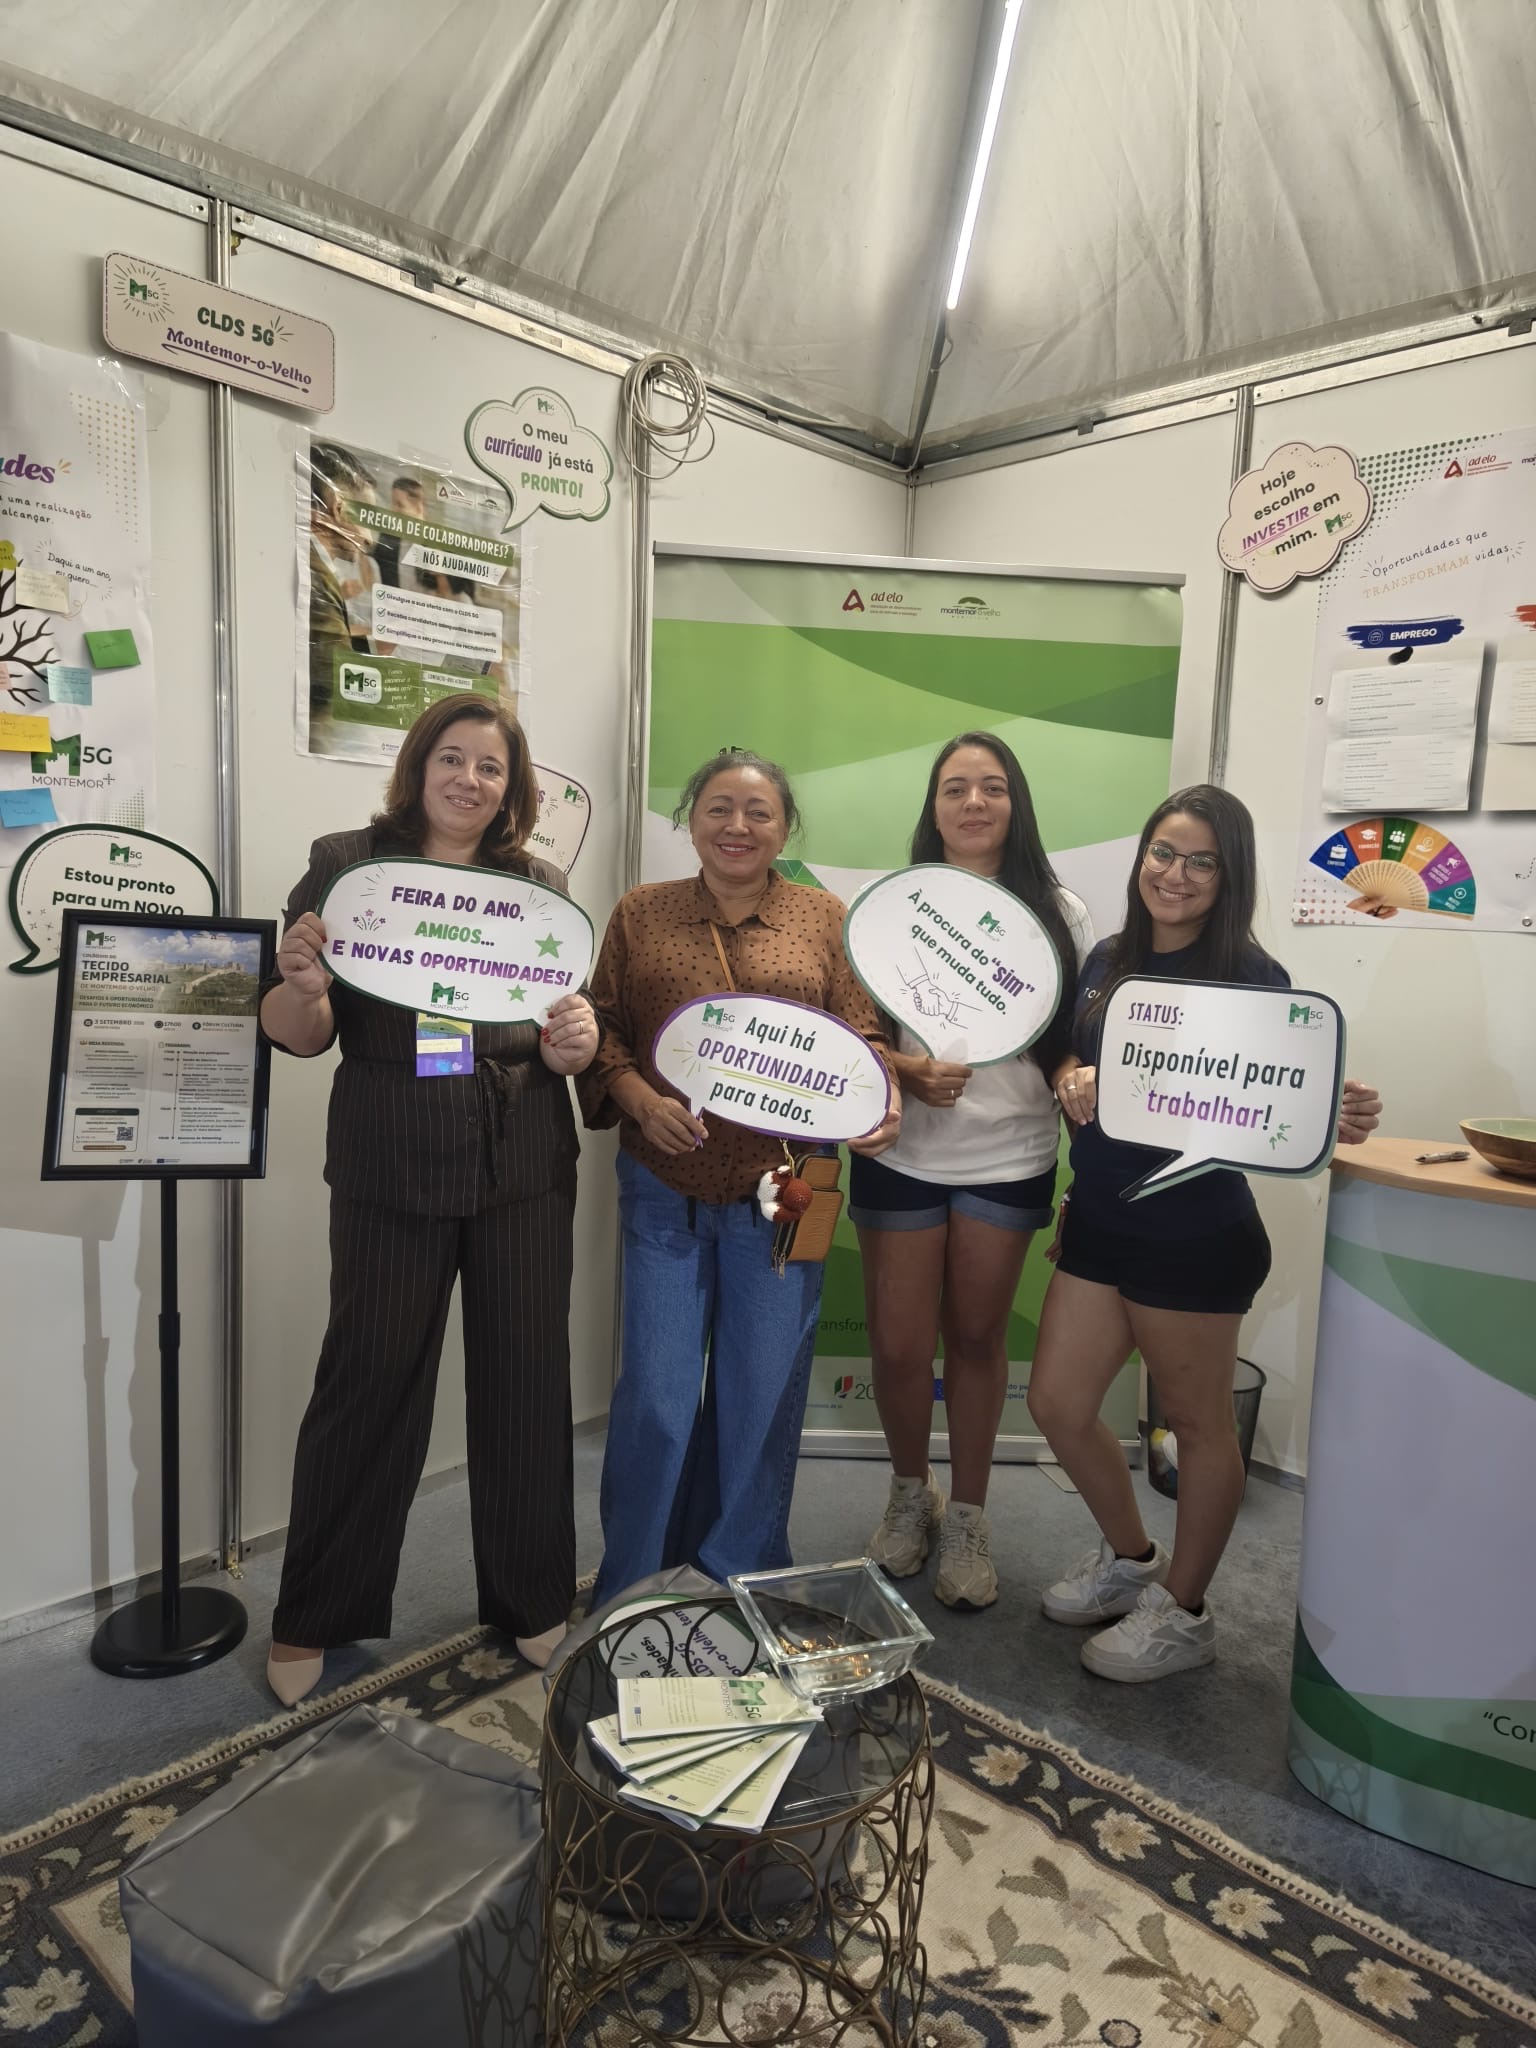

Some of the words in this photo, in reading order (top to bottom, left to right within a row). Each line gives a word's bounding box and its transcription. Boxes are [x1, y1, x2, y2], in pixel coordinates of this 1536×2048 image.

[197, 306, 245, 337] CLDS
[251, 324, 275, 347] 5G
[166, 327, 312, 385] Montemor-o-Velho
[522, 423, 533, 436] O
[537, 428, 568, 445] meu
[484, 436, 543, 463] currículo
[548, 452, 562, 469] já
[565, 457, 594, 473] está
[521, 472, 583, 498] PRONTO!
[1260, 470, 1296, 494] Hoje
[8, 496, 31, 506] uma
[35, 501, 93, 520] realização
[1254, 482, 1315, 520] escolho
[359, 508, 403, 532] PRECISA
[406, 522, 421, 536] DE
[422, 525, 509, 559] COLABORADORES?
[1242, 506, 1310, 550] INVESTIR
[1313, 492, 1340, 513] em
[1275, 529, 1318, 555] mim.
[1372, 534, 1461, 577] Oportunidades
[1465, 530, 1489, 544] que
[48, 552, 73, 569] Daqui
[75, 562, 81, 570] a
[82, 564, 95, 574] um
[97, 569, 112, 581] ano,
[422, 550, 440, 566] NÓS
[441, 559, 490, 578] AJUDAMOS!
[1362, 555, 1470, 599] TRANSFORMAM
[1475, 545, 1514, 562] vidas.
[1390, 627, 1438, 642] EMPREGO
[64, 867, 114, 887] Estou
[118, 873, 176, 896] pronto
[52, 890, 97, 906] para
[101, 896, 130, 913] um
[134, 900, 185, 916] NOVO
[391, 886, 446, 909] FEIRA
[452, 895, 477, 913] DO
[482, 900, 525, 922] ANO,
[414, 920, 495, 948] AMIGOS...
[907, 888, 923, 905] À
[917, 900, 972, 951] procura
[971, 944, 990, 967] do
[81, 971, 172, 985] EMPRESARIAL
[82, 959, 130, 972] TECIDO
[332, 939, 346, 956] E
[351, 942, 414, 965] NOVAS
[419, 951, 573, 987] OPORTUNIDADES!
[910, 924, 938, 949] que
[936, 946, 977, 985] muda
[975, 979, 1007, 1016] tudo.
[1127, 1002, 1184, 1026] STATUS:
[744, 1016, 789, 1044] Aqui
[789, 1029, 817, 1053] há
[697, 1037, 849, 1098] OPORTUNIDADES
[1121, 1042, 1240, 1080] Disponível
[1243, 1061, 1306, 1090] para
[709, 1081, 754, 1107] para
[758, 1092, 815, 1126] todos.
[1147, 1089, 1273, 1132] trabalhar!
